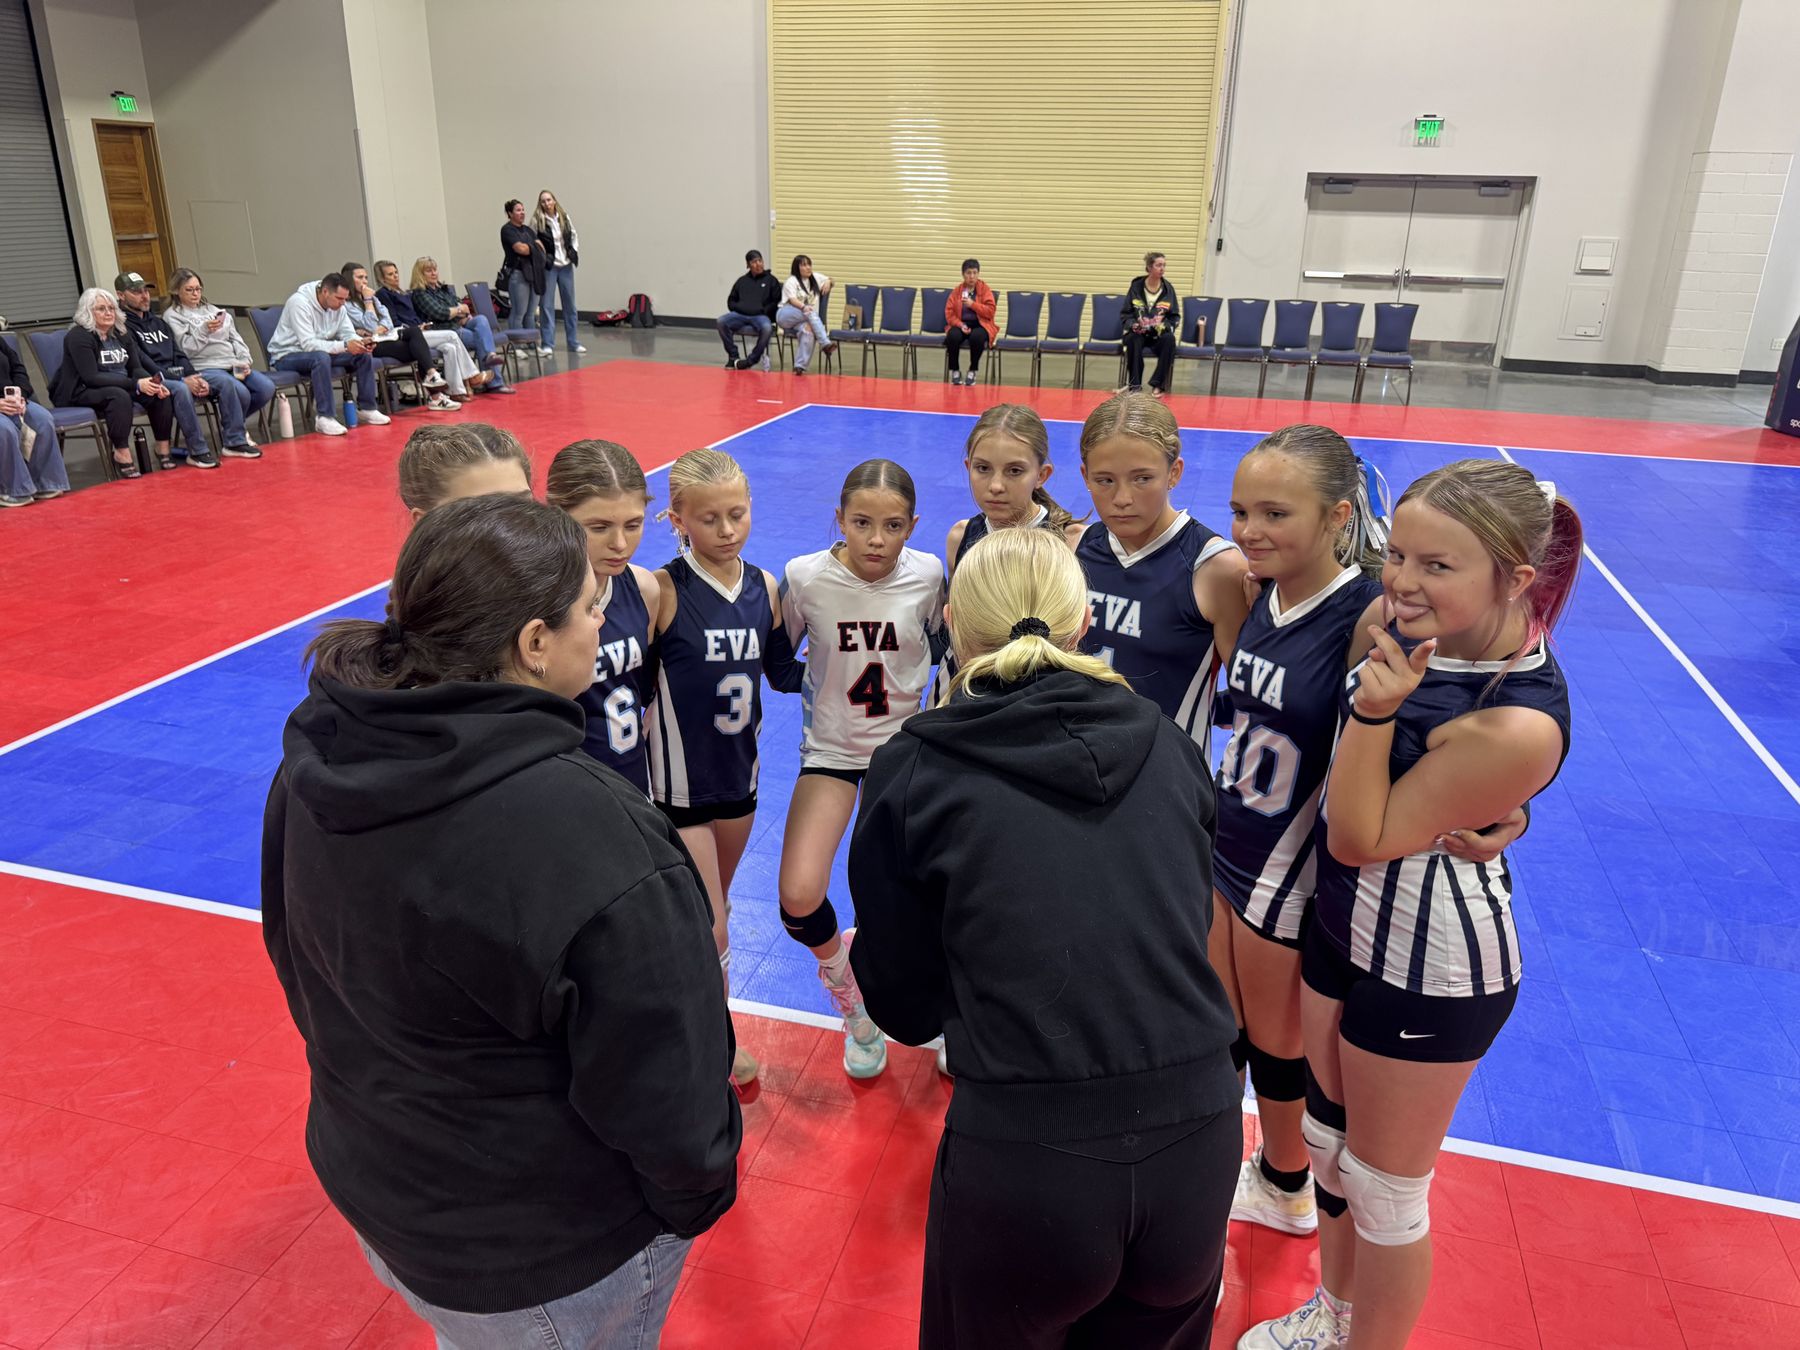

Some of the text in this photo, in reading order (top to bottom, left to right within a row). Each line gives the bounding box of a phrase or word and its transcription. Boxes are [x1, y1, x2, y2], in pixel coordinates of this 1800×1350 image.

[118, 96, 139, 112] EXIT
[1418, 121, 1440, 138] EXIT
[592, 636, 643, 684] EVA
[704, 628, 760, 662] EVA
[837, 621, 899, 652] EVA
[713, 672, 754, 735] 3
[847, 661, 890, 718] 4
[1229, 648, 1287, 712] EVA
[603, 684, 639, 755] 6
[1220, 708, 1302, 818] 10
